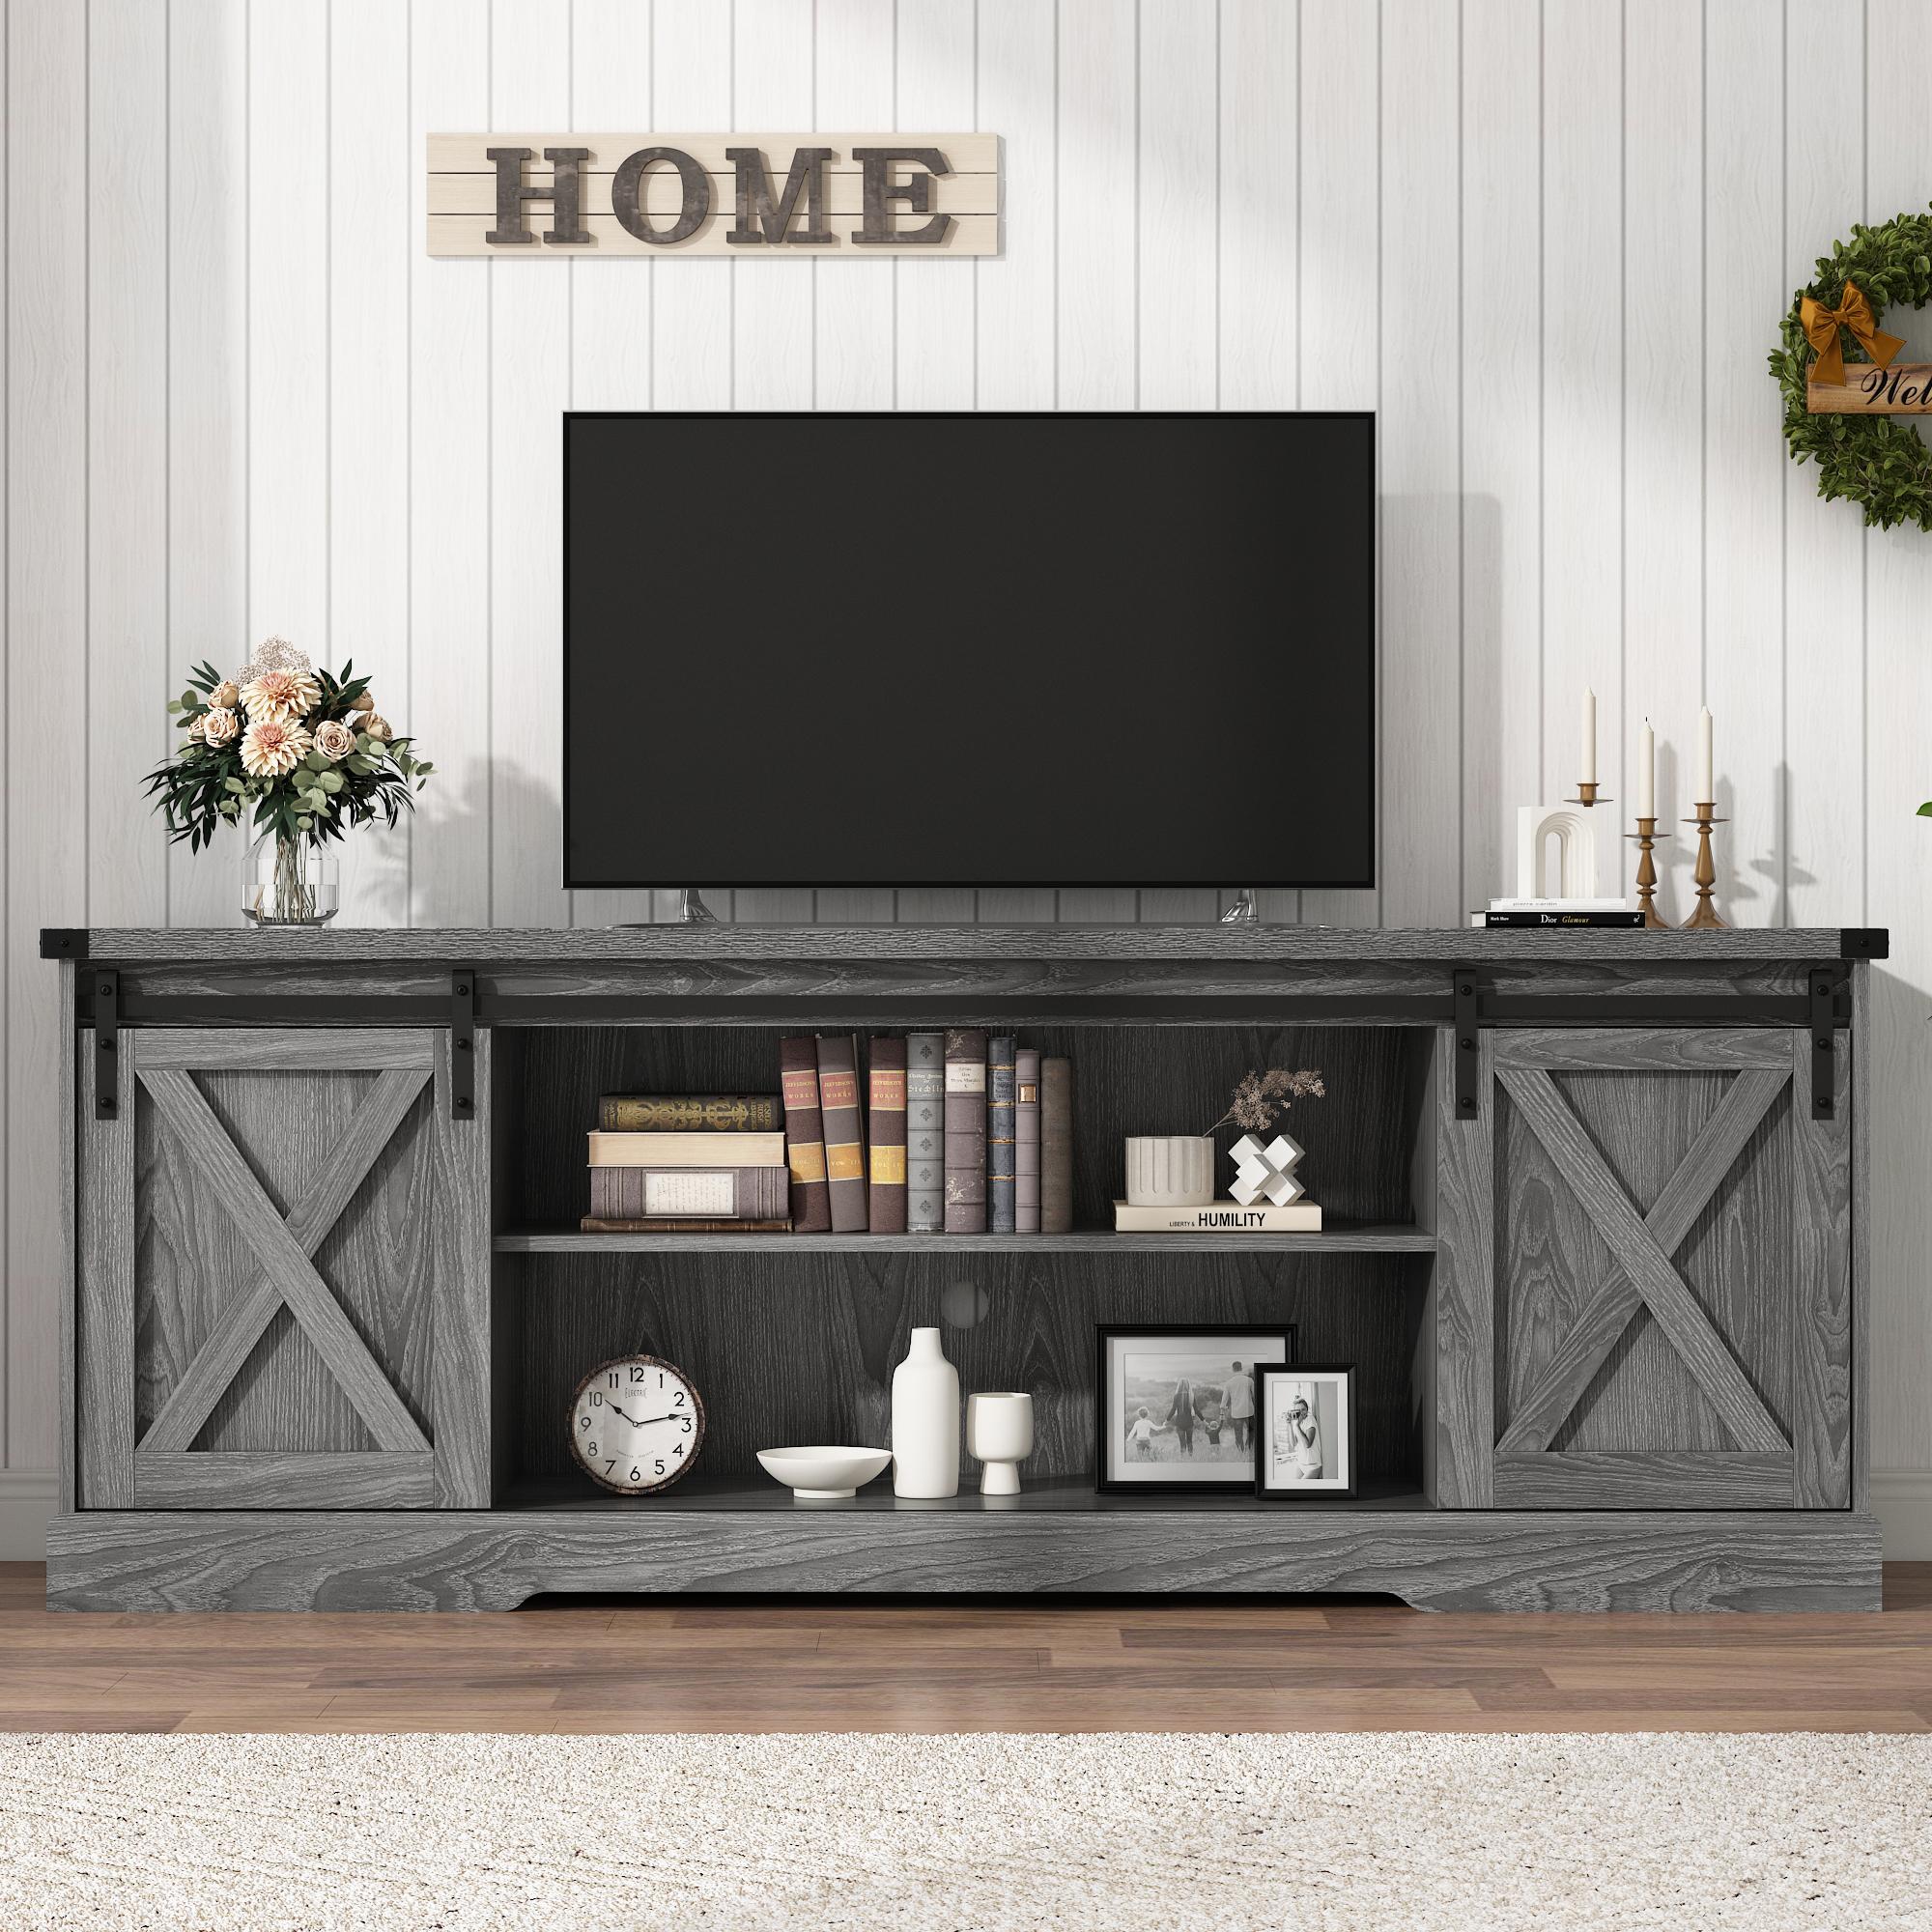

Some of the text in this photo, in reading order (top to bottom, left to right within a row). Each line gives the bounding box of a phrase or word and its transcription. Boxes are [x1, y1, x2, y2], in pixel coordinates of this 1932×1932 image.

[486, 146, 951, 243] HOME
[1541, 914, 1590, 923] Dior Glamour
[1198, 1212, 1265, 1227] HUMILITY
[609, 1373, 619, 1388] 11
[630, 1367, 644, 1382] 12
[659, 1373, 664, 1388] 1
[588, 1391, 603, 1406] 10
[673, 1391, 685, 1406] 2
[581, 1416, 591, 1432] 9
[681, 1417, 692, 1433] 3
[587, 1441, 598, 1457] 8
[672, 1443, 684, 1457] 4
[605, 1460, 616, 1475] 7
[630, 1465, 640, 1481] 6
[654, 1460, 665, 1475] 5
